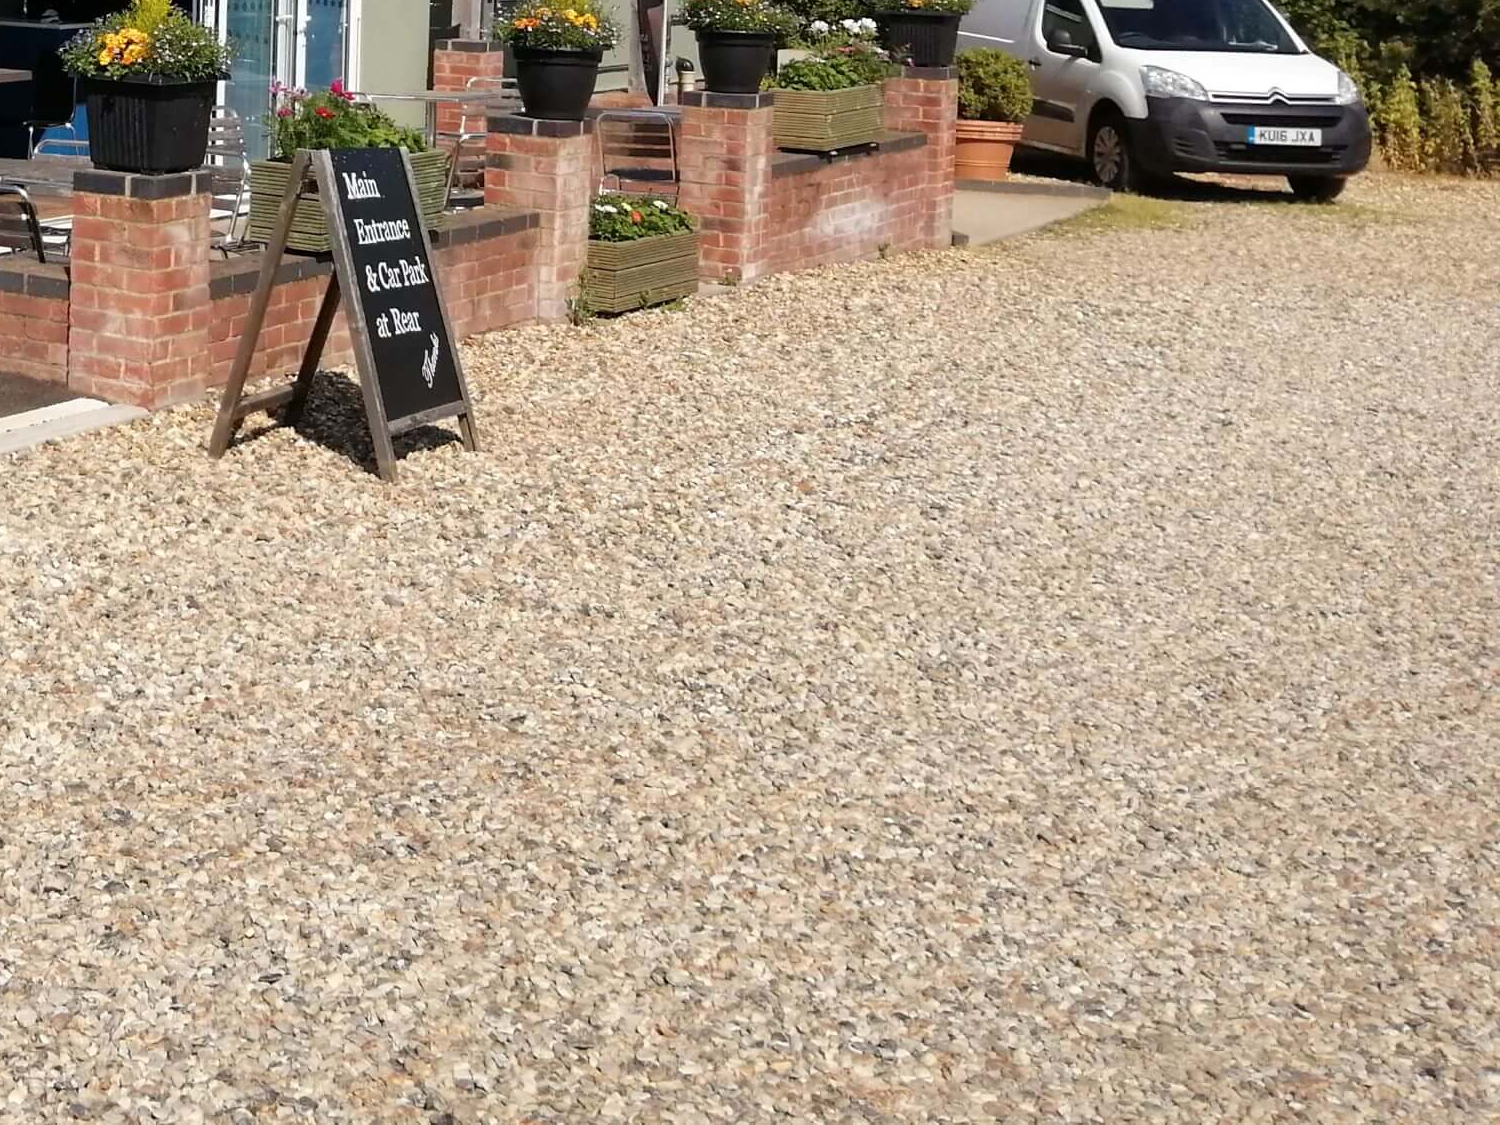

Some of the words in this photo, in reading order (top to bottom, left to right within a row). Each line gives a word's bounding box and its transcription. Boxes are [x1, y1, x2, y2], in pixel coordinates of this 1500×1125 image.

[1292, 130, 1315, 143] JXA
[343, 171, 381, 200] Main
[354, 218, 410, 245] Entrance
[365, 264, 380, 293] &
[378, 261, 401, 288] Car
[399, 256, 429, 286] Park
[376, 312, 392, 338] at
[391, 308, 422, 336] Rear
